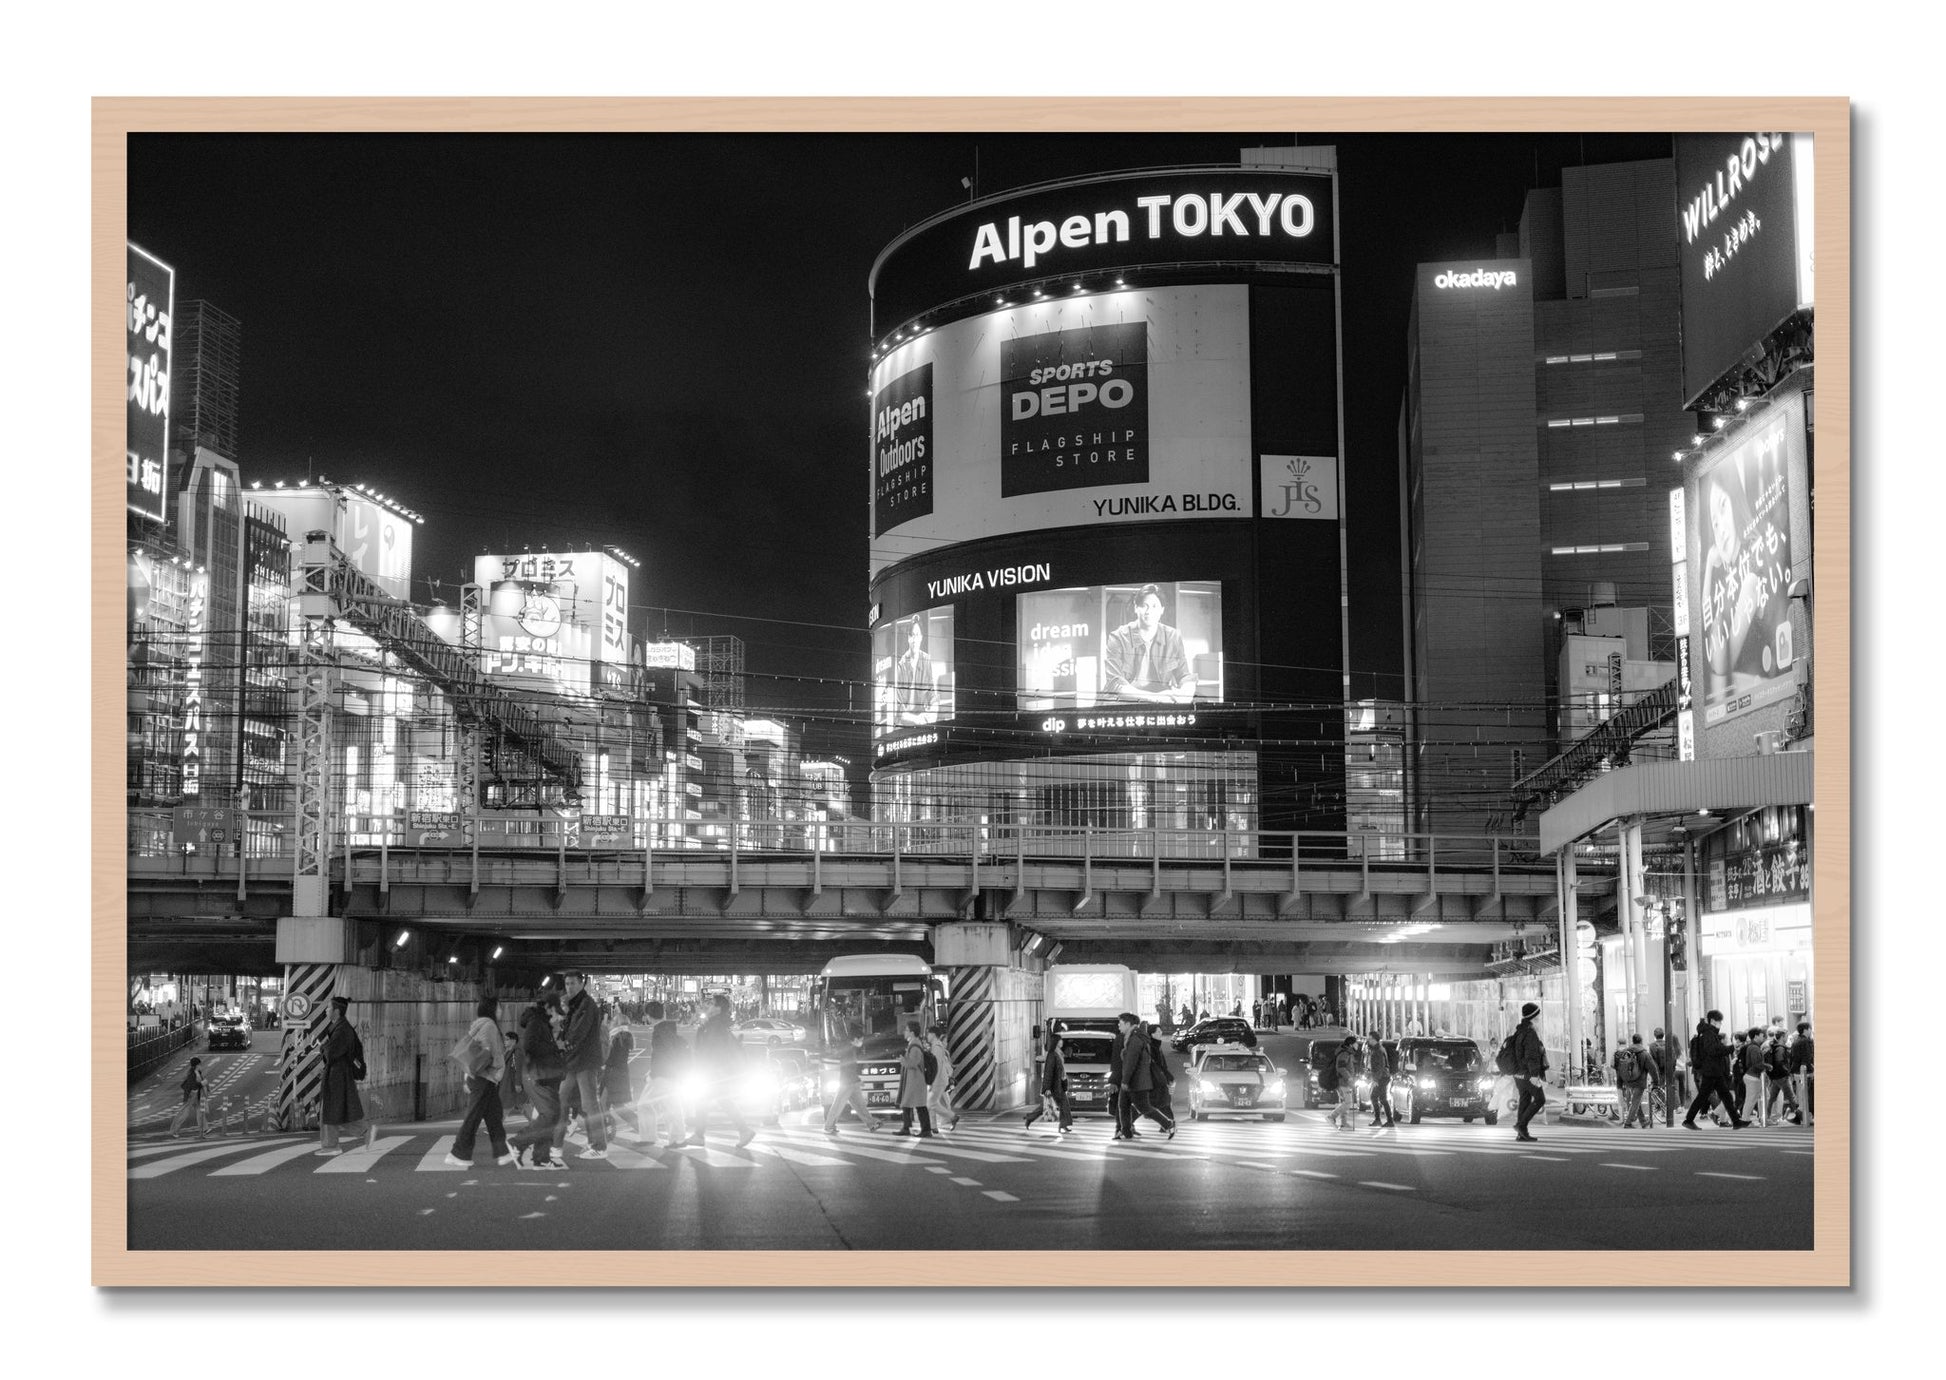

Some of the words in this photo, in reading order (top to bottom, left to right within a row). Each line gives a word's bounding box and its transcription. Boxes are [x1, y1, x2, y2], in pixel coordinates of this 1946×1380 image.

[968, 207, 1131, 270] Alpen
[1137, 192, 1315, 239] TOKYO
[1434, 268, 1517, 290] okadaya
[1029, 359, 1113, 385] SPORTS
[1012, 379, 1134, 421] DEPO
[877, 395, 926, 443] Alpen
[1011, 430, 1135, 455] FLAGSHIP
[880, 435, 926, 478] Outdoors
[1055, 449, 1135, 467] STORE
[876, 465, 927, 500] FLAGSHIP
[890, 482, 927, 507] STORE
[1093, 496, 1177, 516] YUNIKA
[1182, 493, 1241, 512] BLDG.
[254, 563, 286, 586] SHISHA
[928, 573, 984, 599] YUNIKA
[988, 563, 1051, 587] VISION
[1030, 622, 1089, 641] dream
[1042, 717, 1066, 733] dip
